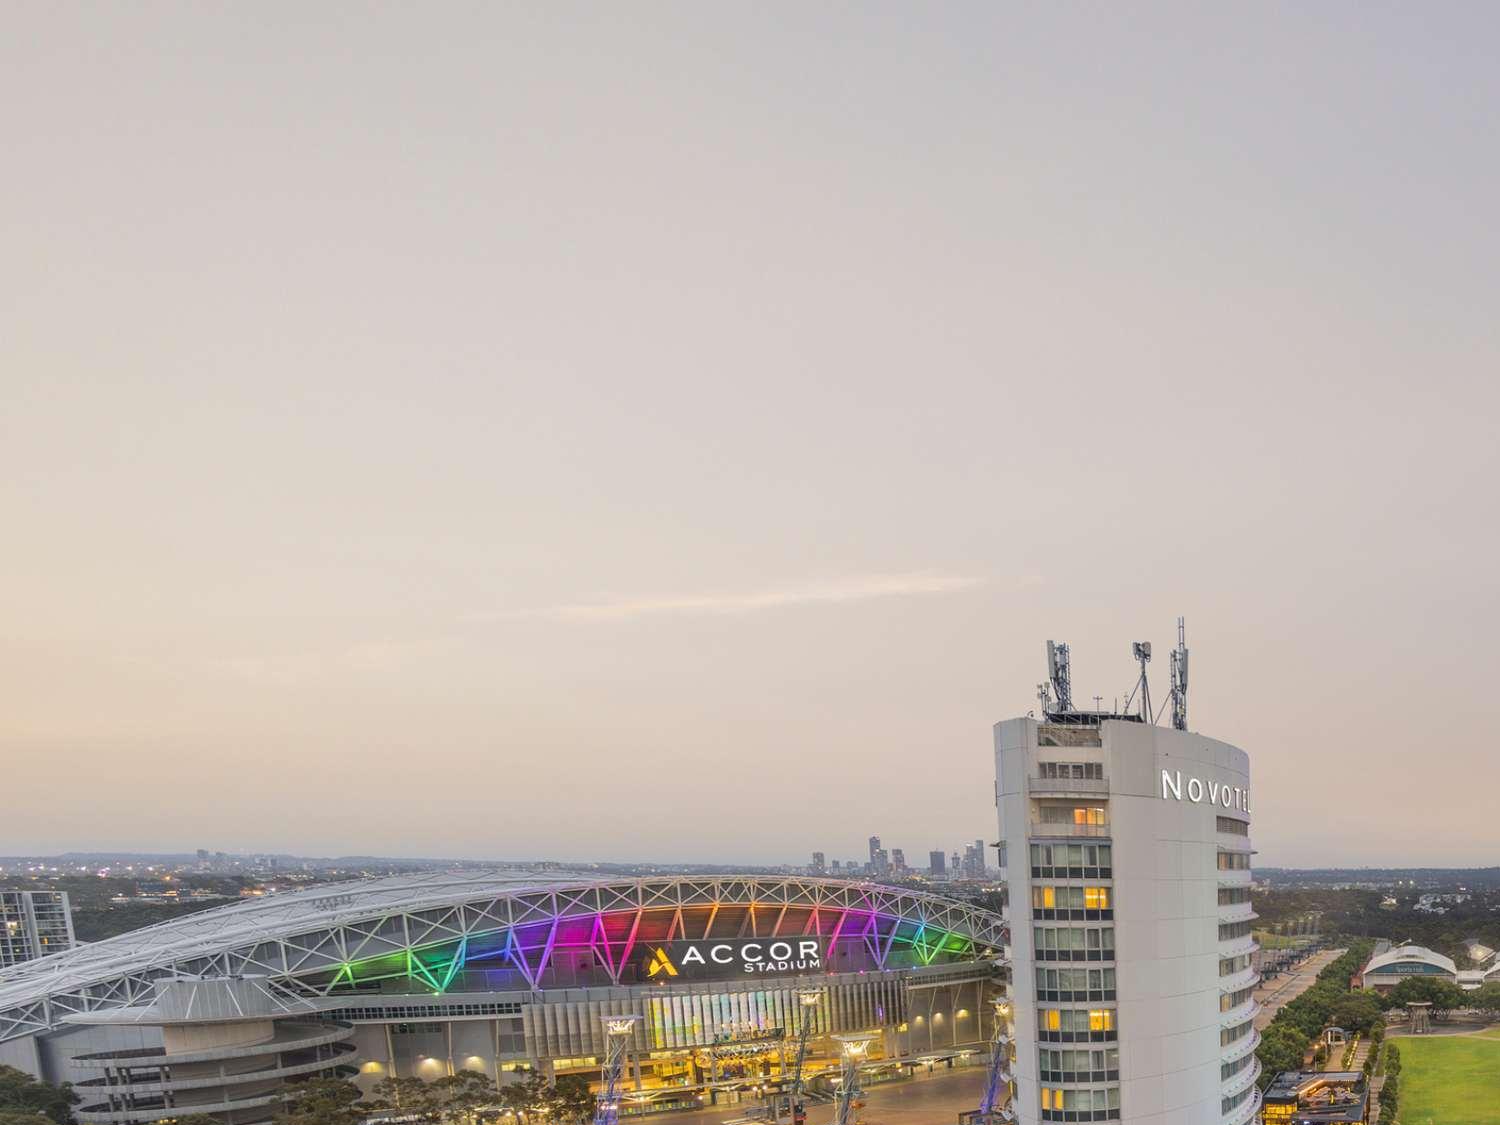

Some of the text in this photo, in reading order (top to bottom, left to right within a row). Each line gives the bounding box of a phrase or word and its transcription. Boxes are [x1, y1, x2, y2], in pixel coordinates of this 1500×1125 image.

[1161, 769, 1251, 813] NOVOTEL
[682, 941, 819, 965] ACCOR
[743, 959, 820, 973] STADIUM
